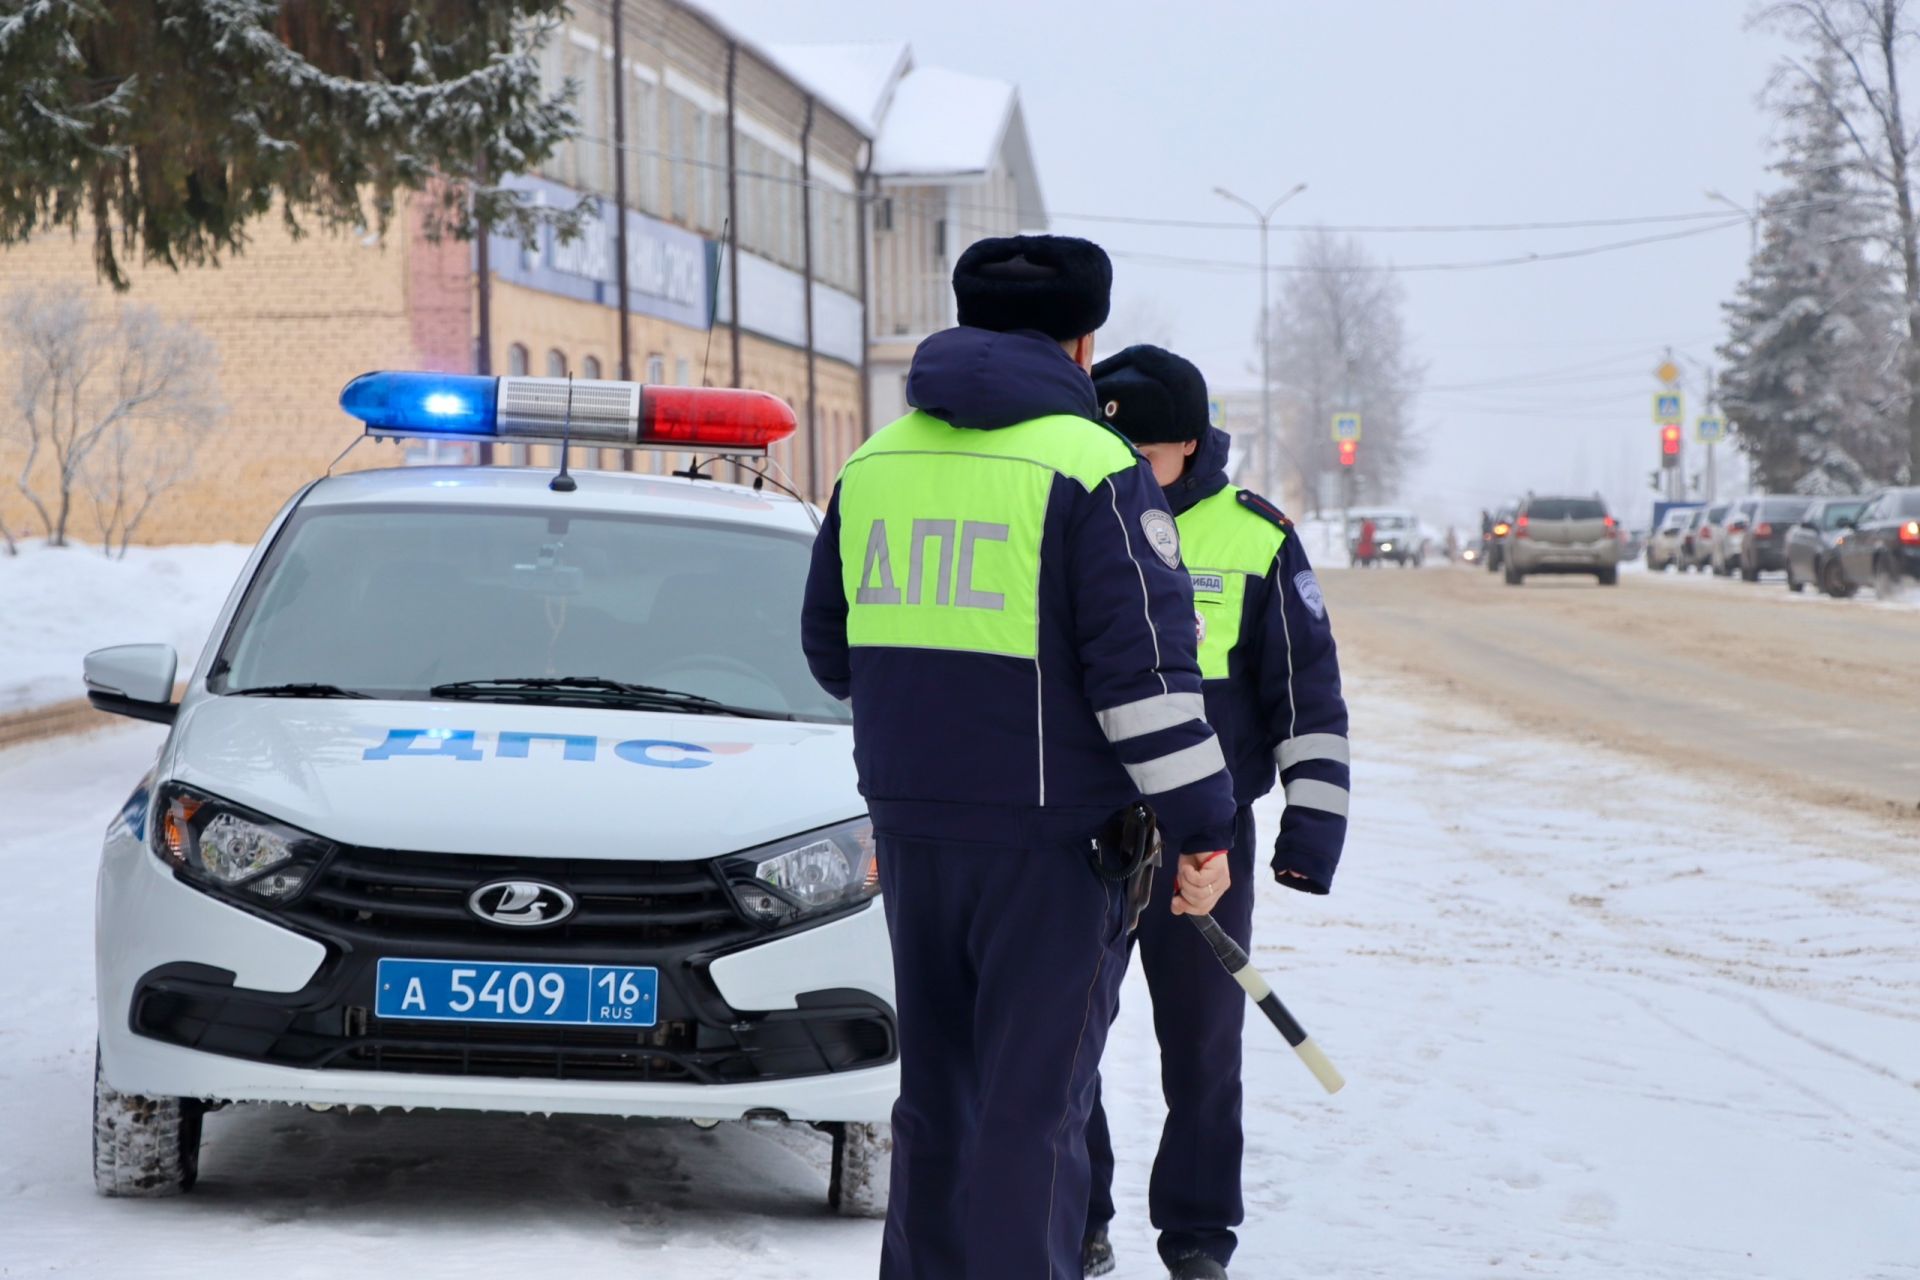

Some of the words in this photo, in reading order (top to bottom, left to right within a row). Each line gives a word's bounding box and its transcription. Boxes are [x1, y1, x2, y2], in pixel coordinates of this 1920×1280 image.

[856, 518, 1010, 611] ДПС
[1192, 577, 1221, 590] ИБДД
[361, 728, 714, 770] ДПС
[448, 968, 566, 1016] 5409
[597, 971, 640, 1006] 16
[600, 1005, 633, 1020] RUS
